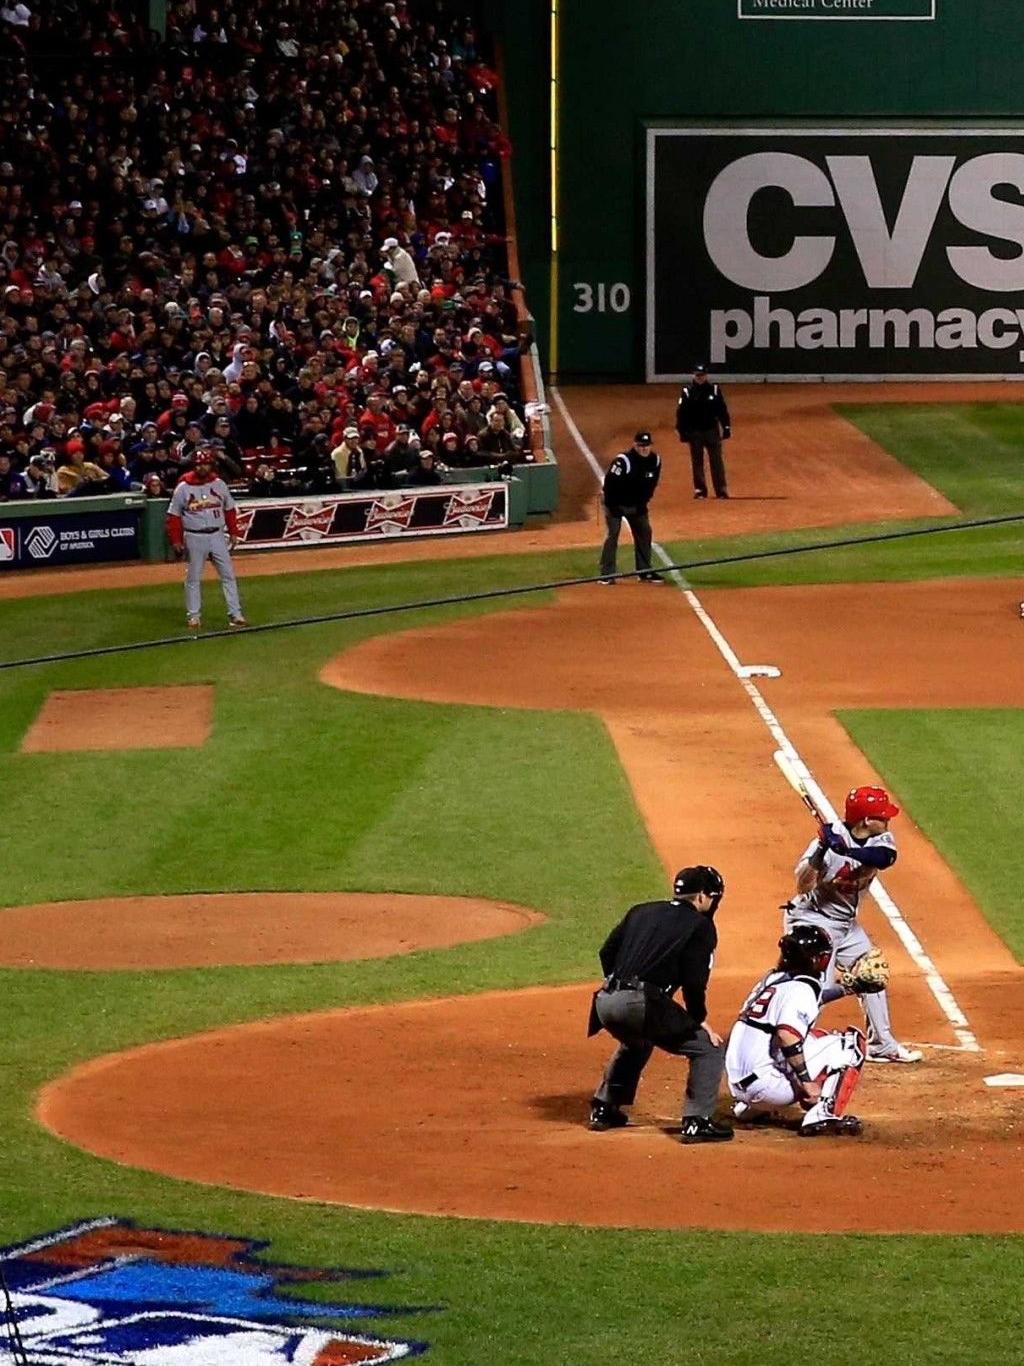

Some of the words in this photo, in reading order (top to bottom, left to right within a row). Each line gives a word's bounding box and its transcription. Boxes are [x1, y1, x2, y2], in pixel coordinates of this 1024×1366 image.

[573, 282, 630, 313] 310
[60, 532, 80, 540] BOYS
[81, 531, 87, 539] &
[88, 529, 110, 538] GIRLS
[111, 527, 135, 537] CLUBS
